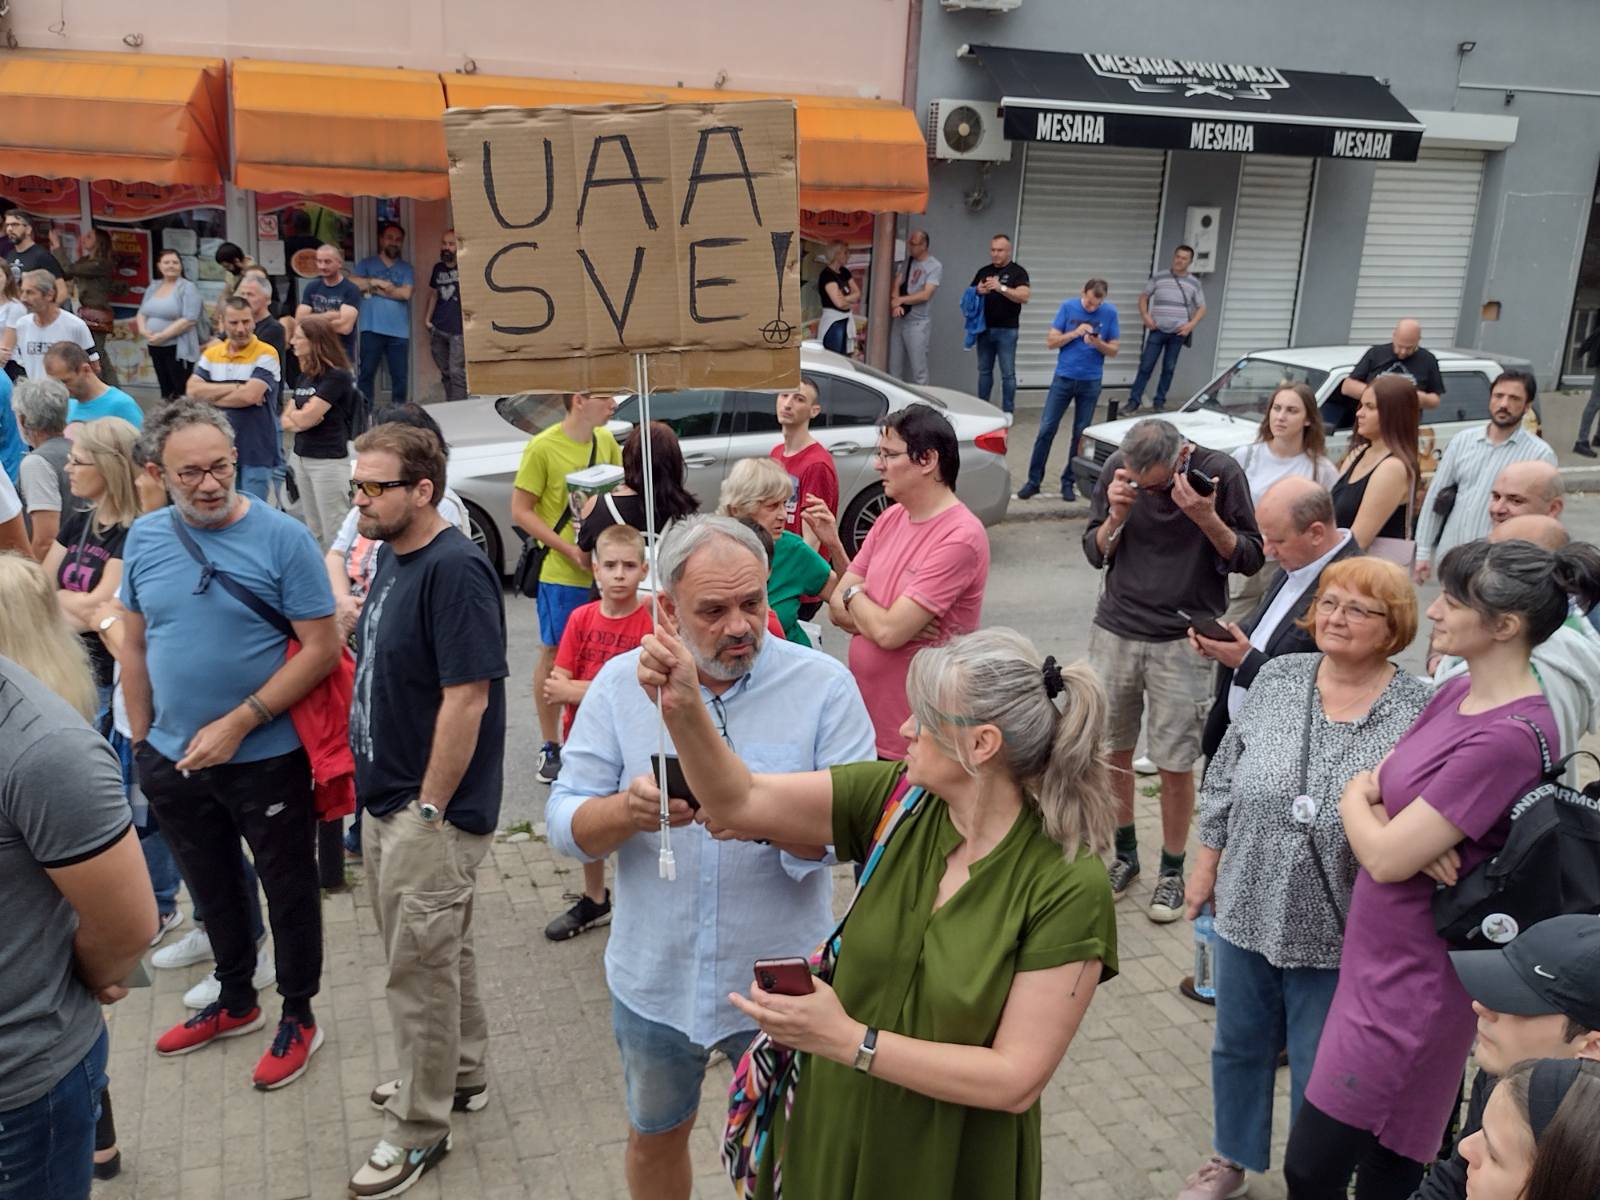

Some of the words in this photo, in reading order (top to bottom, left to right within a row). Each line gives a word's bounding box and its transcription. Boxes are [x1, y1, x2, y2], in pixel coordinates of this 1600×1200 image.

[1036, 112, 1105, 144] MESARA
[1190, 122, 1254, 152] MESARA
[1332, 130, 1393, 159] MESARA
[483, 126, 778, 232] UAA
[484, 231, 796, 345] SVE!
[1553, 786, 1600, 812] ARMO
